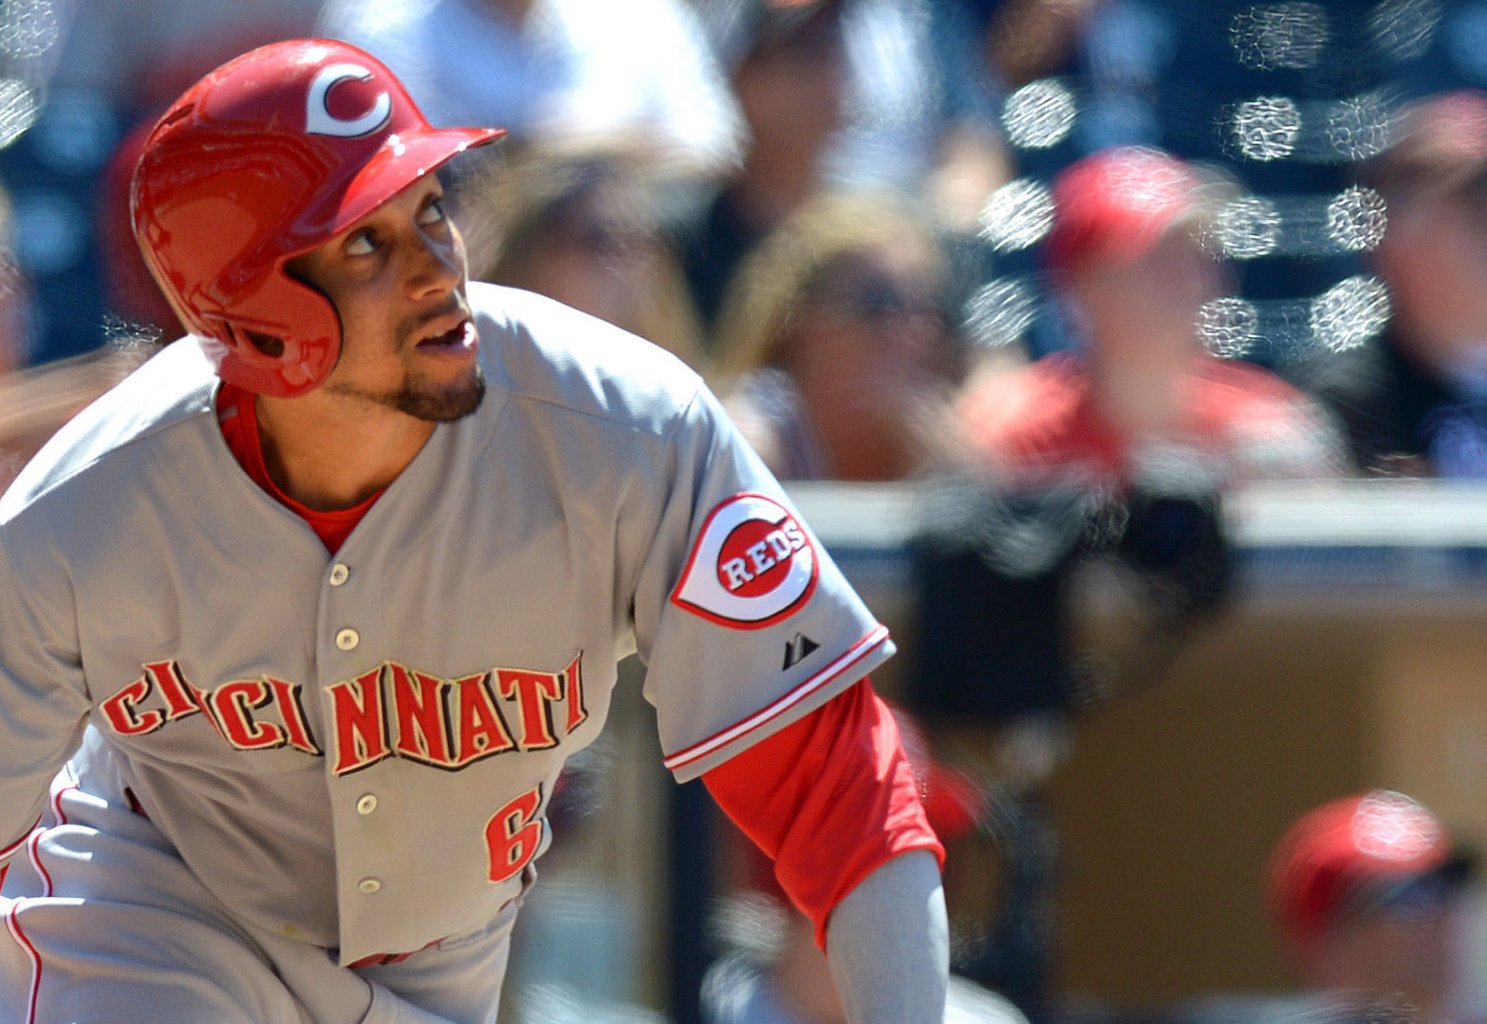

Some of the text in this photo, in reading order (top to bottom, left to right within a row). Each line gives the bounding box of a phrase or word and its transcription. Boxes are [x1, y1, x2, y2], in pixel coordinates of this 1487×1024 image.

[306, 63, 392, 139] C
[720, 518, 806, 591] REDS
[99, 650, 588, 777] CICINNATI
[483, 783, 544, 884] 6
